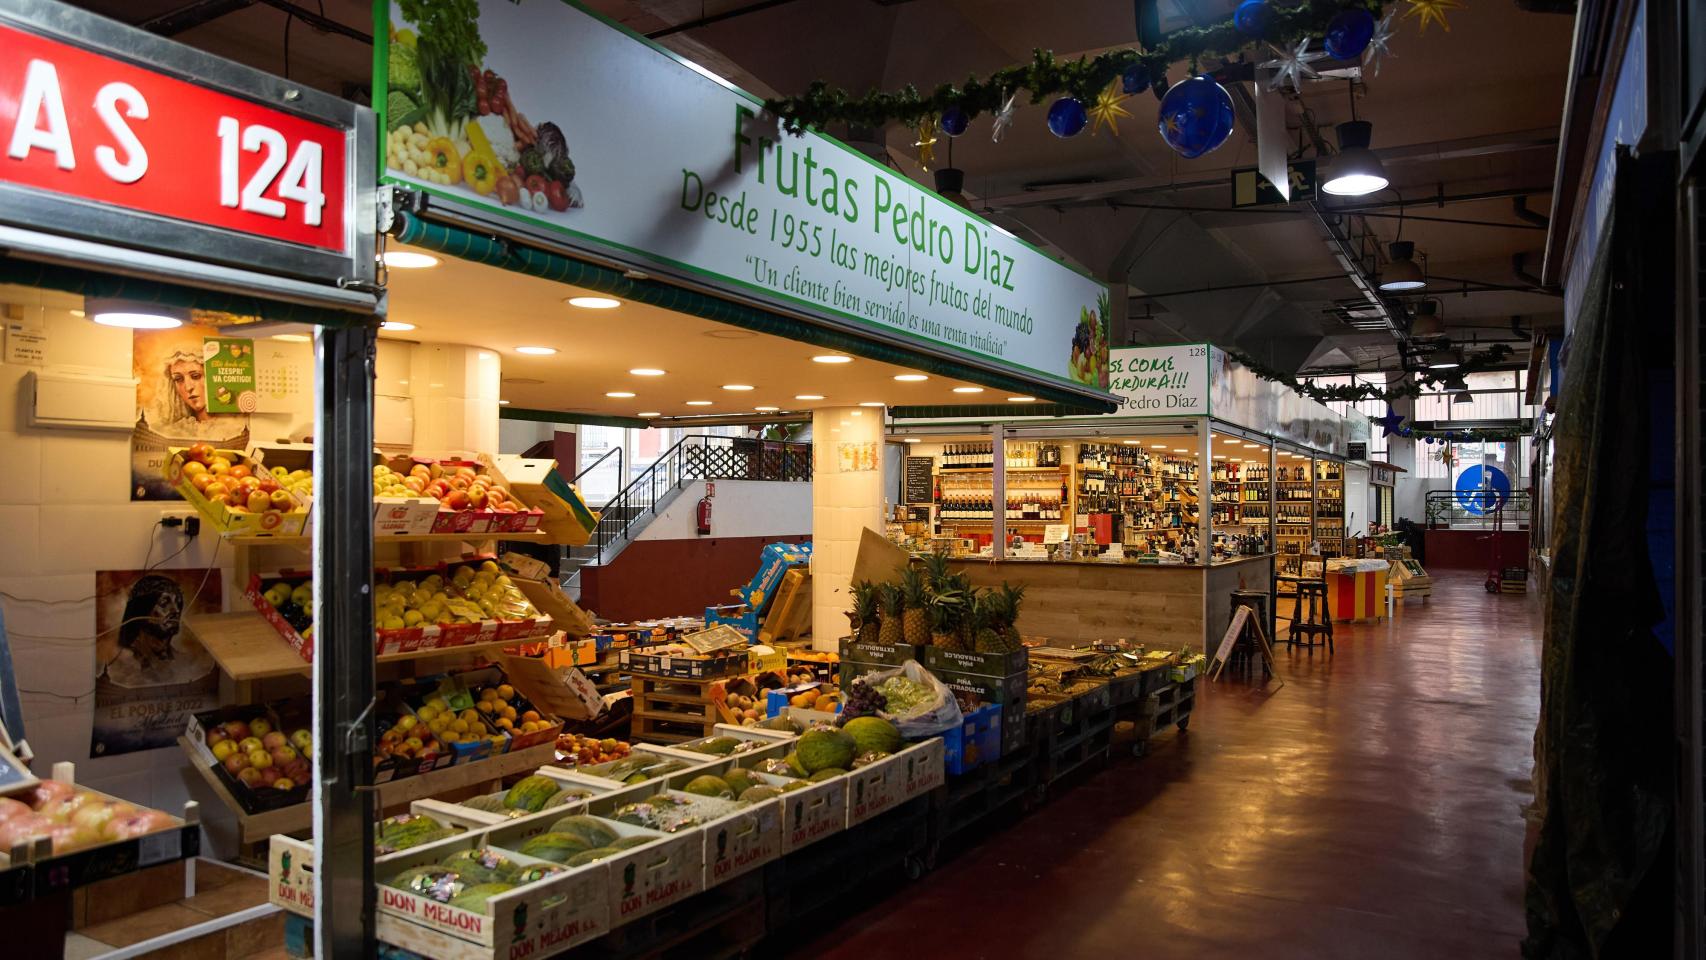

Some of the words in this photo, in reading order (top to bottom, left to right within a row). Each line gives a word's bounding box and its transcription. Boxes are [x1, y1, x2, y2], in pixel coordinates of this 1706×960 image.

[217, 116, 325, 226] 124
[734, 102, 859, 223] Frutas
[874, 174, 954, 265] Pedro
[964, 221, 1016, 291] Diaz
[681, 168, 759, 235] Desde
[771, 208, 823, 258] 1955
[830, 229, 858, 271] las
[864, 252, 926, 297] mejores
[929, 269, 969, 314] frutas
[973, 289, 991, 320] del
[995, 297, 1034, 336] mundo
[784, 266, 829, 303] cliente
[833, 280, 861, 313] bien
[864, 295, 906, 327] servido
[909, 315, 919, 330] es
[921, 317, 941, 338] una
[944, 324, 968, 346] renta
[1189, 348, 1206, 357] 128
[1109, 358, 1124, 373] SE
[1128, 356, 1175, 373] COME
[1108, 371, 1189, 391] VERDURA!!!
[1121, 394, 1160, 410] Pedro
[1166, 393, 1198, 409] Díaz
[856, 644, 895, 653] EXTRADULCE
[944, 652, 985, 664] EXTRADULCE
[956, 677, 972, 686] PIÑA
[111, 707, 125, 719] EL
[128, 701, 173, 717] POBRE
[175, 699, 204, 711] 2022
[791, 829, 807, 844] DON
[713, 858, 732, 880] DON
[278, 883, 297, 902] DON
[383, 889, 416, 913] DON
[424, 902, 482, 934] MELON
[620, 895, 642, 915] DON
[509, 938, 535, 960] DON
[540, 920, 580, 949] MELON
